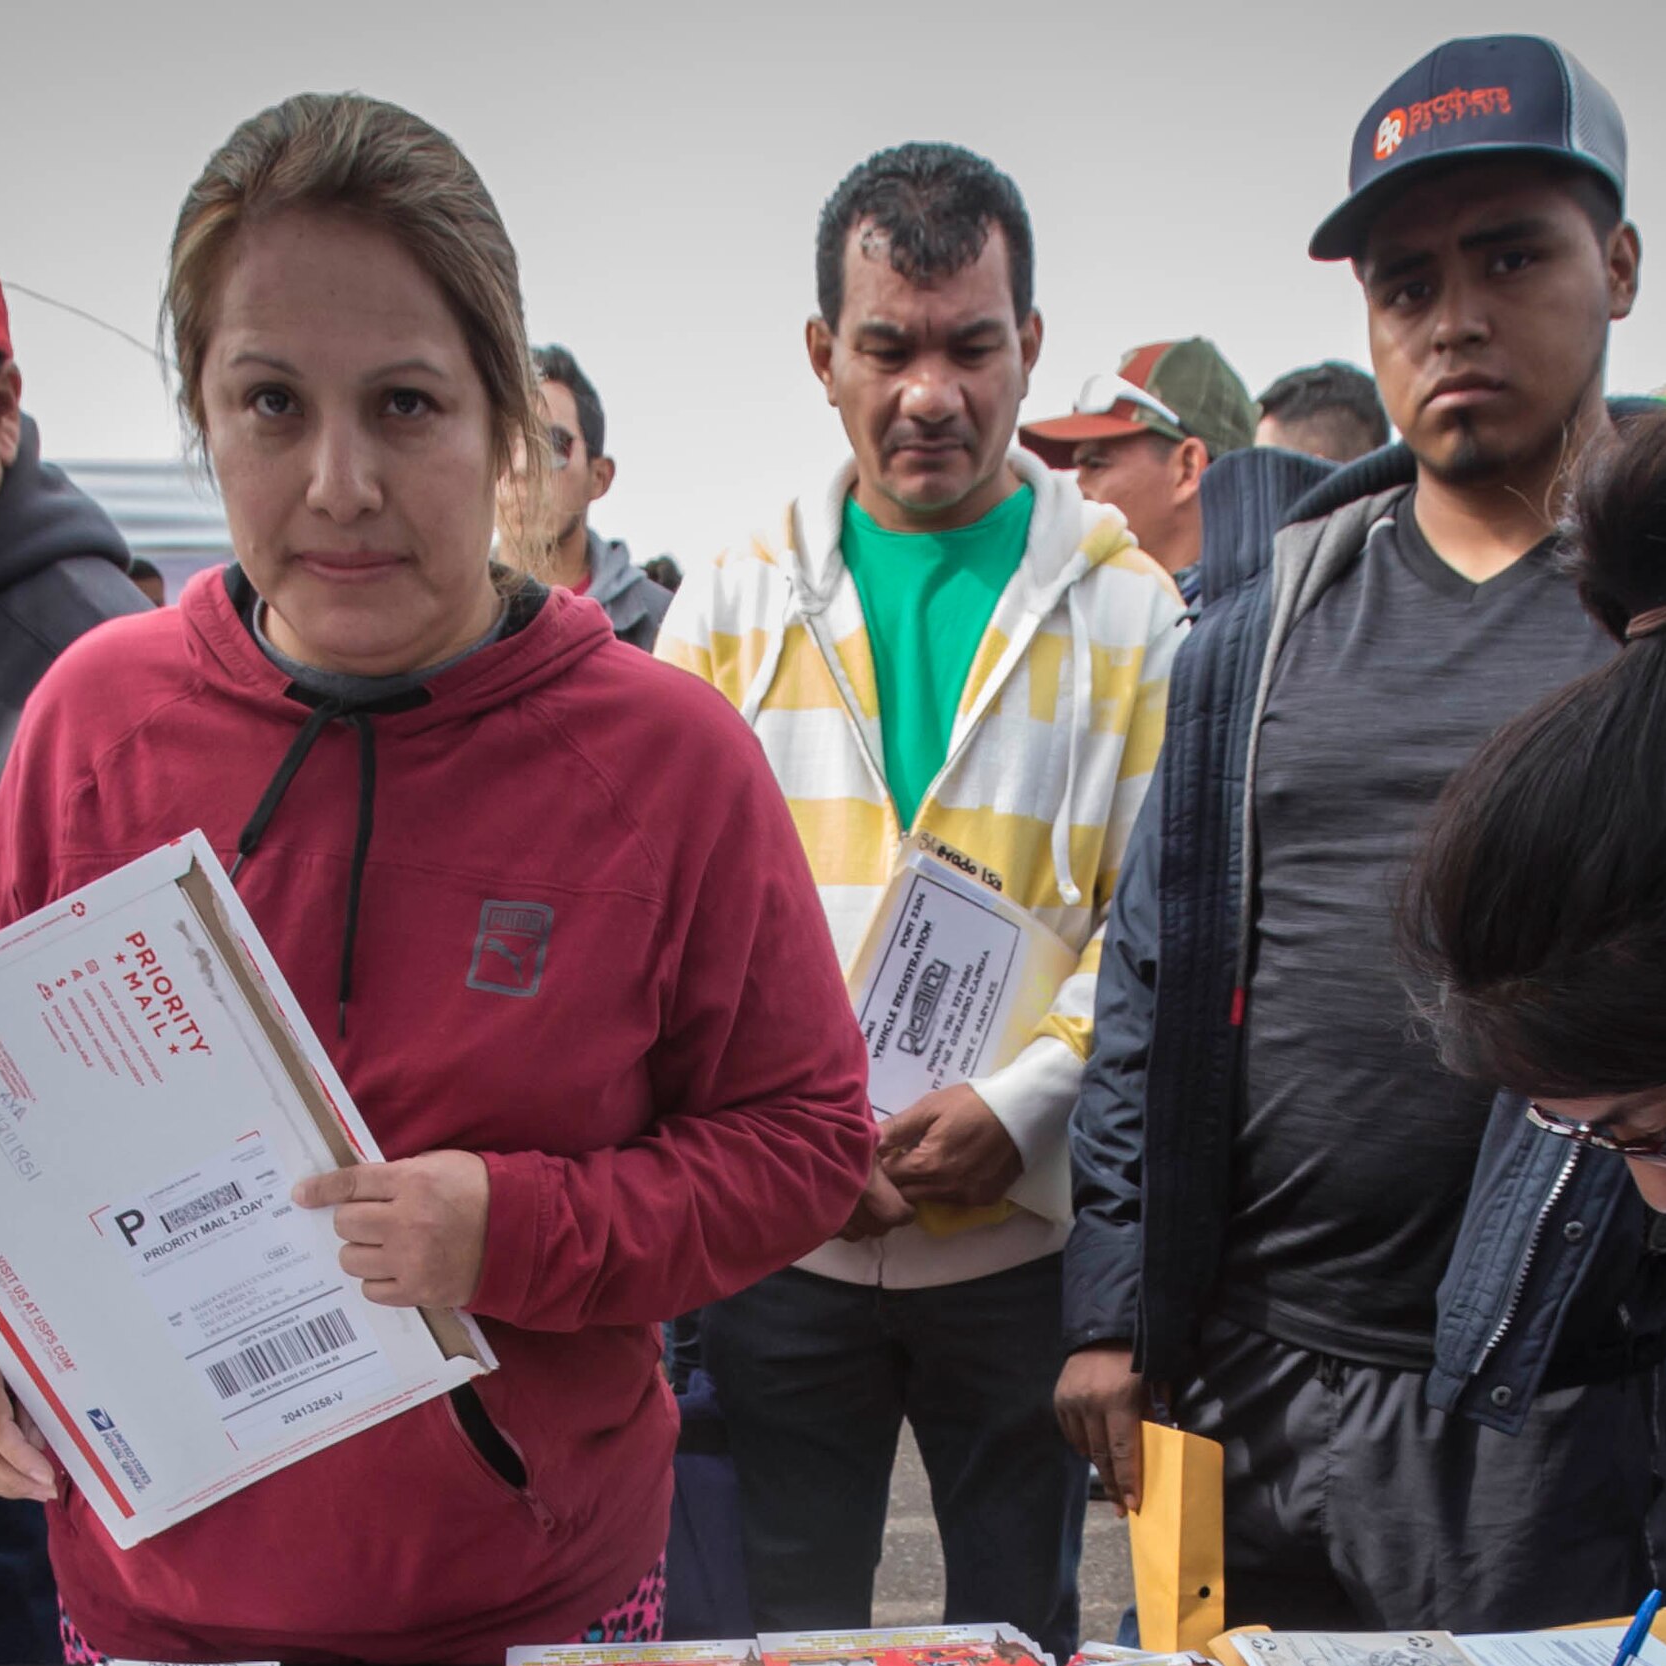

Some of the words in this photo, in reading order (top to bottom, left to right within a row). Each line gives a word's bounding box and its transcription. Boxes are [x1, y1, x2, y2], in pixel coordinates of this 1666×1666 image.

[123, 971, 167, 1037] MAIL
[125, 931, 209, 1050] PRIORITY
[872, 1010, 897, 1058] VEHICLE
[893, 921, 933, 1009] REGISTRATION
[114, 1208, 145, 1246] P
[142, 1228, 197, 1262] PRIORITY
[199, 1216, 229, 1234] MAIL
[12, 1284, 29, 1301] US
[23, 1301, 39, 1314] AT
[257, 1316, 294, 1336] TRACKING
[101, 1430, 122, 1460] POSTAL
[111, 1429, 134, 1459] UNITED
[130, 1457, 151, 1484] STATES
